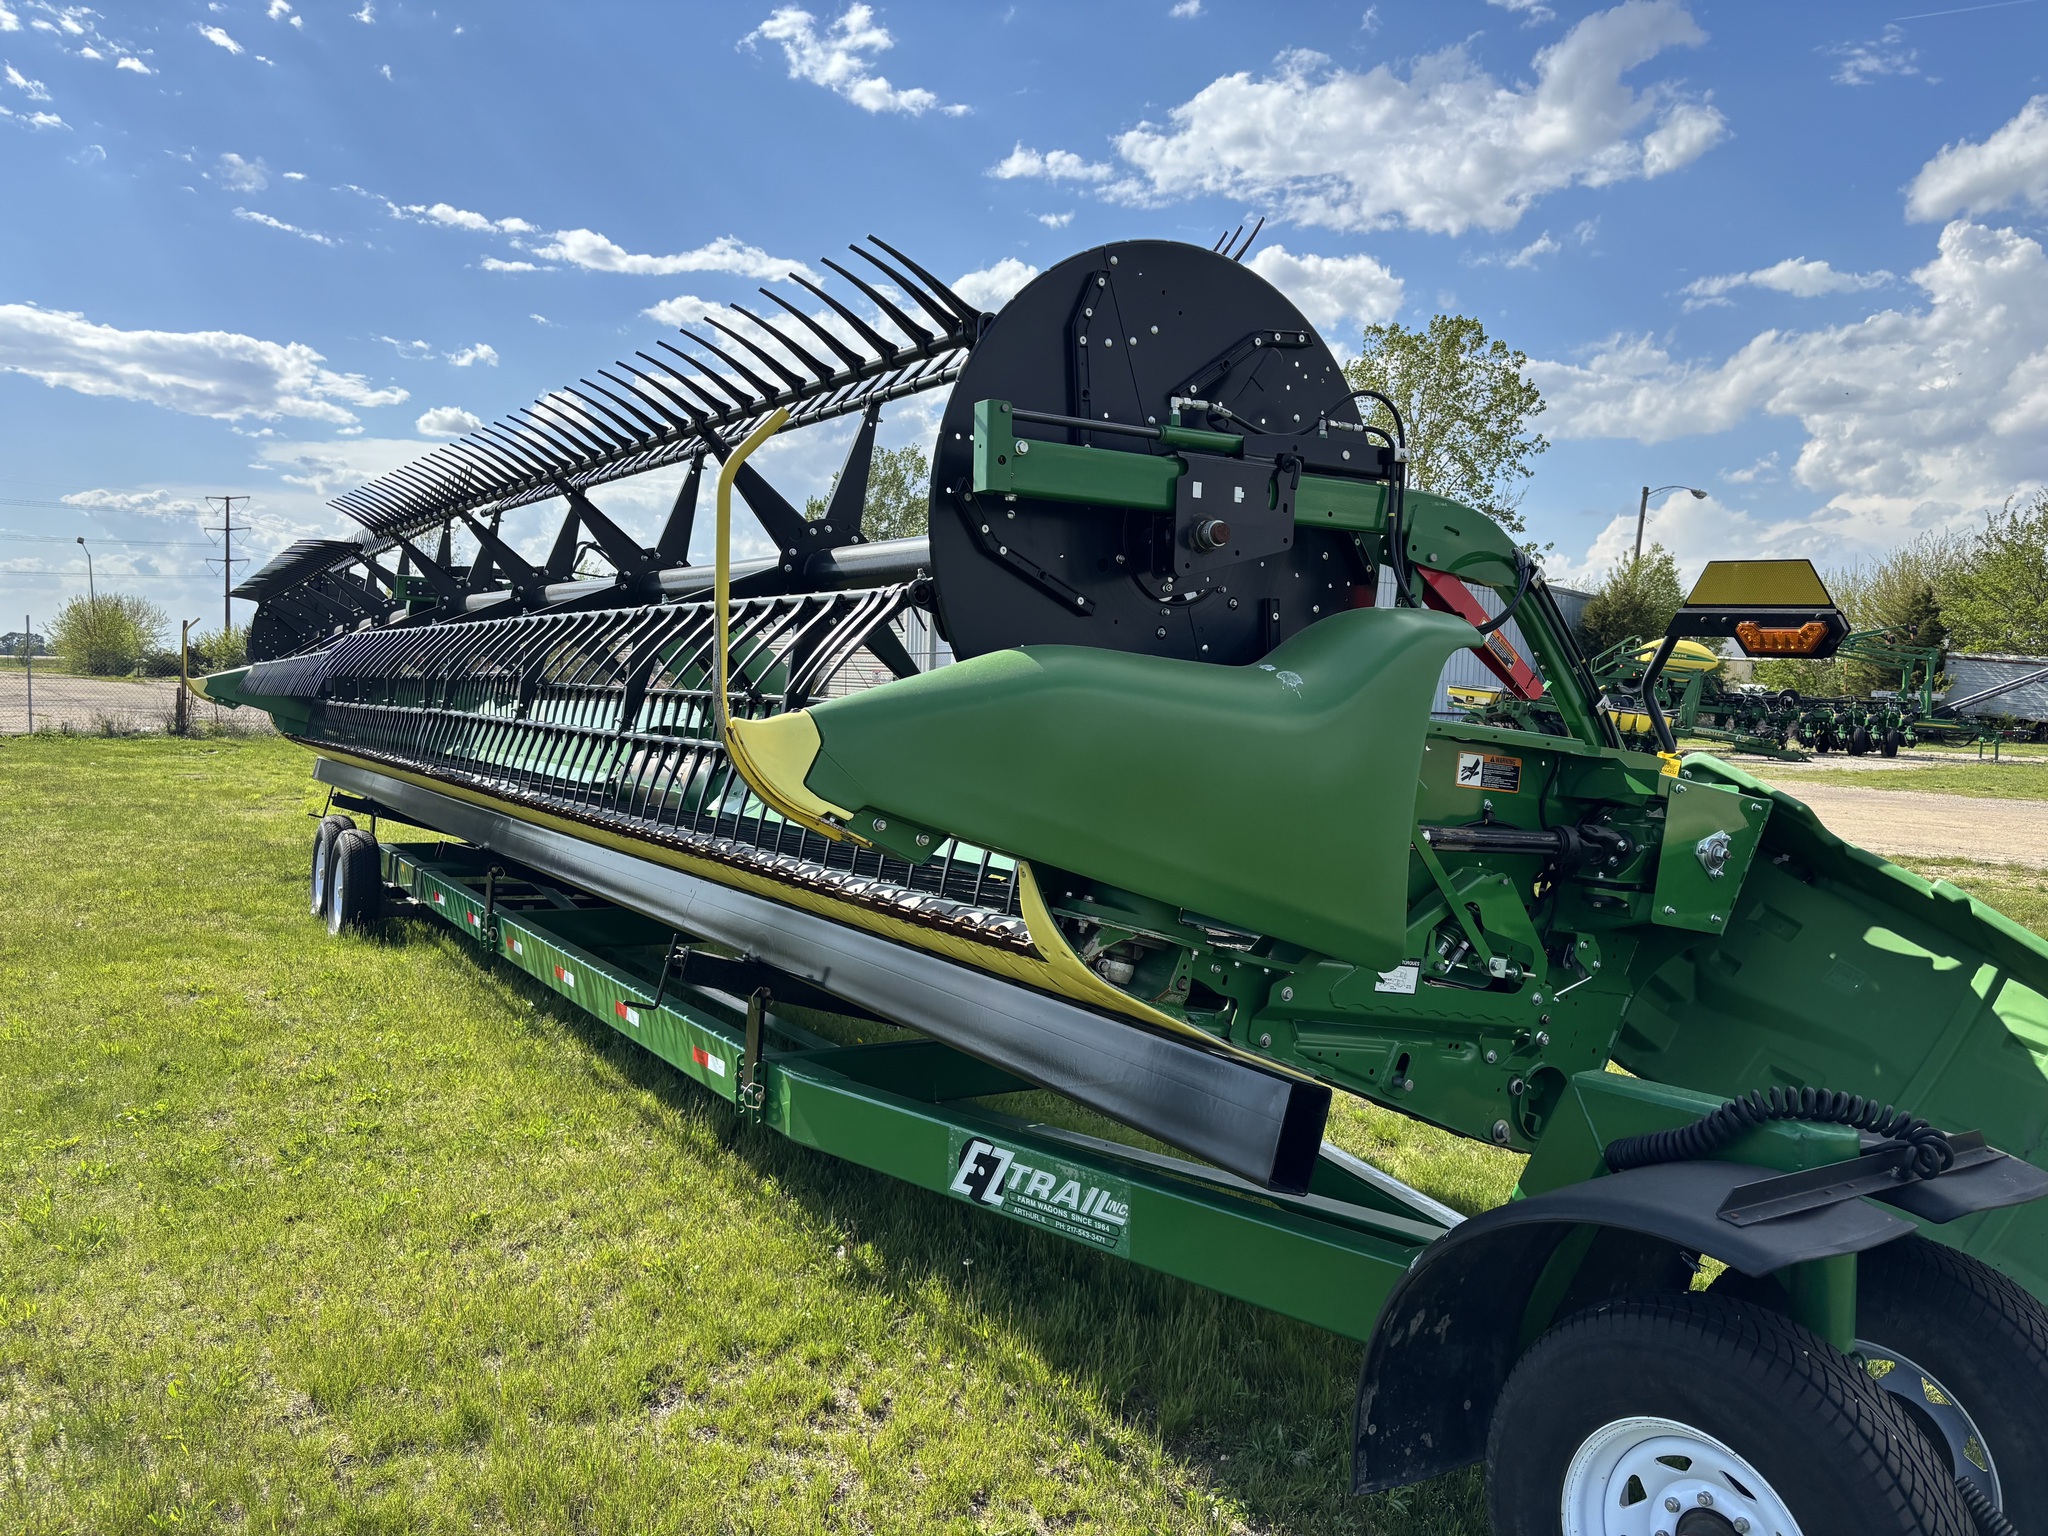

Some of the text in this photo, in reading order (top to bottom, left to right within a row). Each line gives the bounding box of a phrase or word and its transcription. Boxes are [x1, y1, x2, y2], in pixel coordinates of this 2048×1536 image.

[1007, 1162, 1127, 1225] TRAIL
[1017, 1195, 1036, 1207] FARM
[1037, 1201, 1067, 1217] WAGONS
[1071, 1213, 1092, 1226] SINCE
